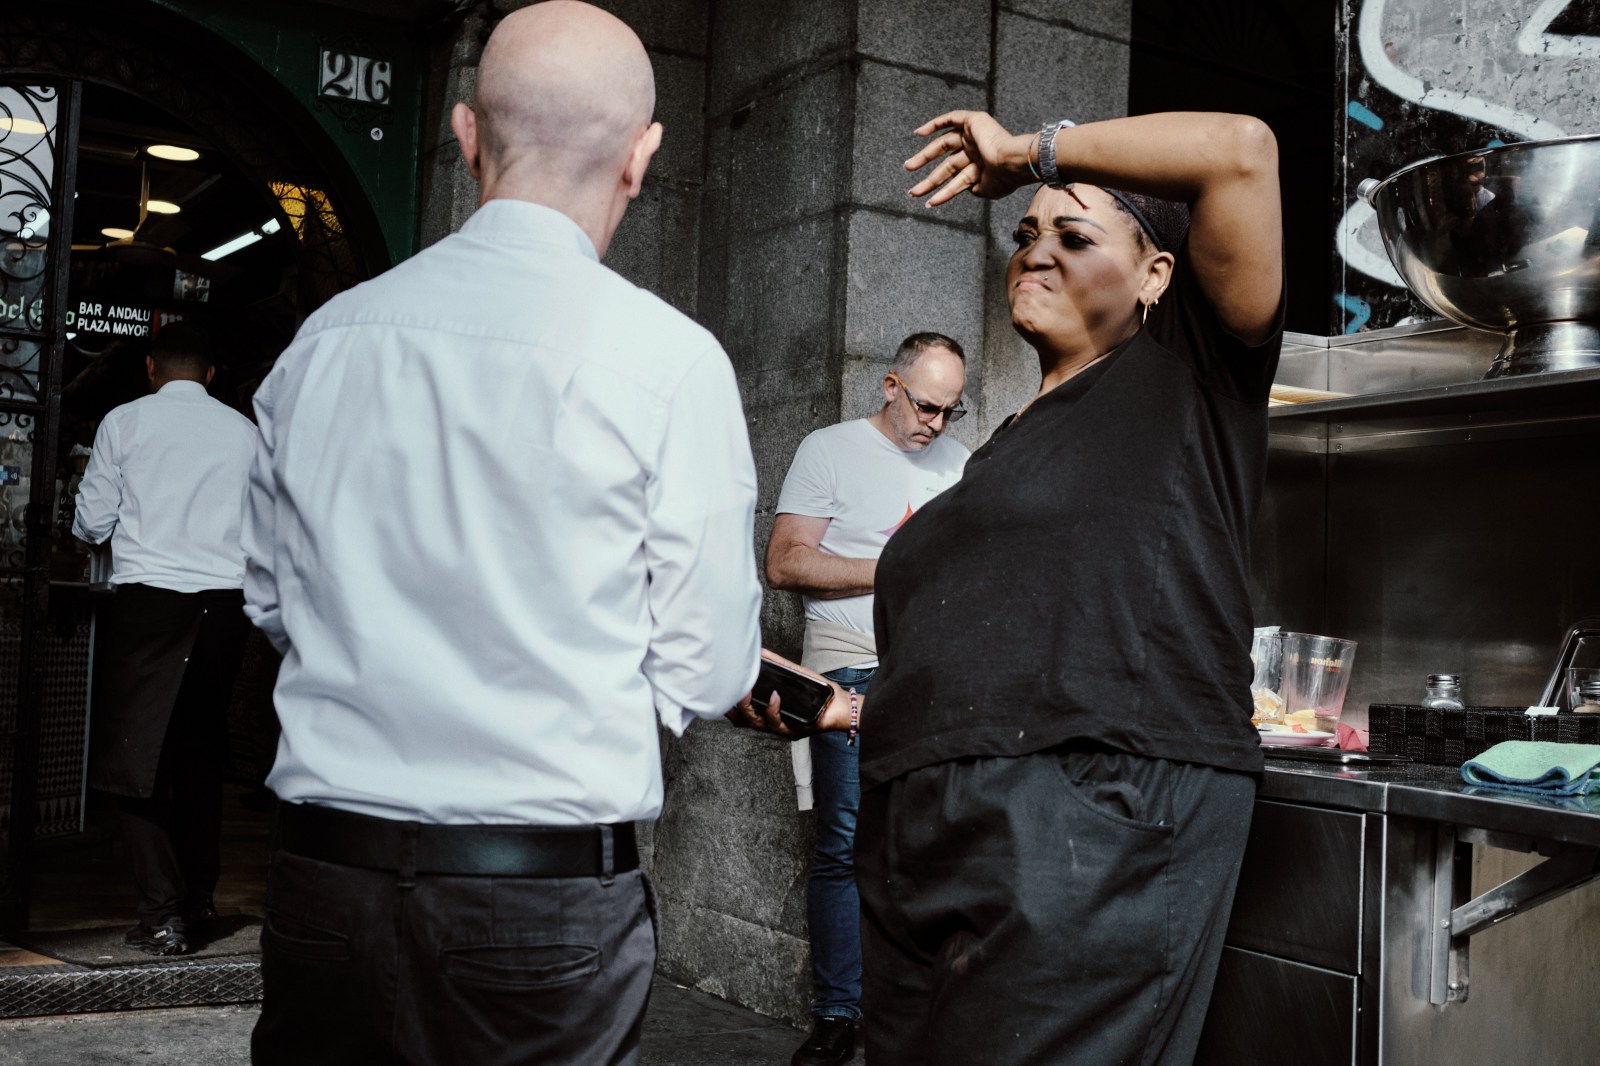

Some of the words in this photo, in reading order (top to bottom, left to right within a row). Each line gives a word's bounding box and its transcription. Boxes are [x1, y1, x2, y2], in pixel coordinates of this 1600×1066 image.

[320, 49, 391, 103] 26
[78, 301, 103, 317] BAR
[107, 305, 151, 322] ANDALU
[77, 317, 111, 334] PLAZA
[112, 321, 149, 337] MAYOR
